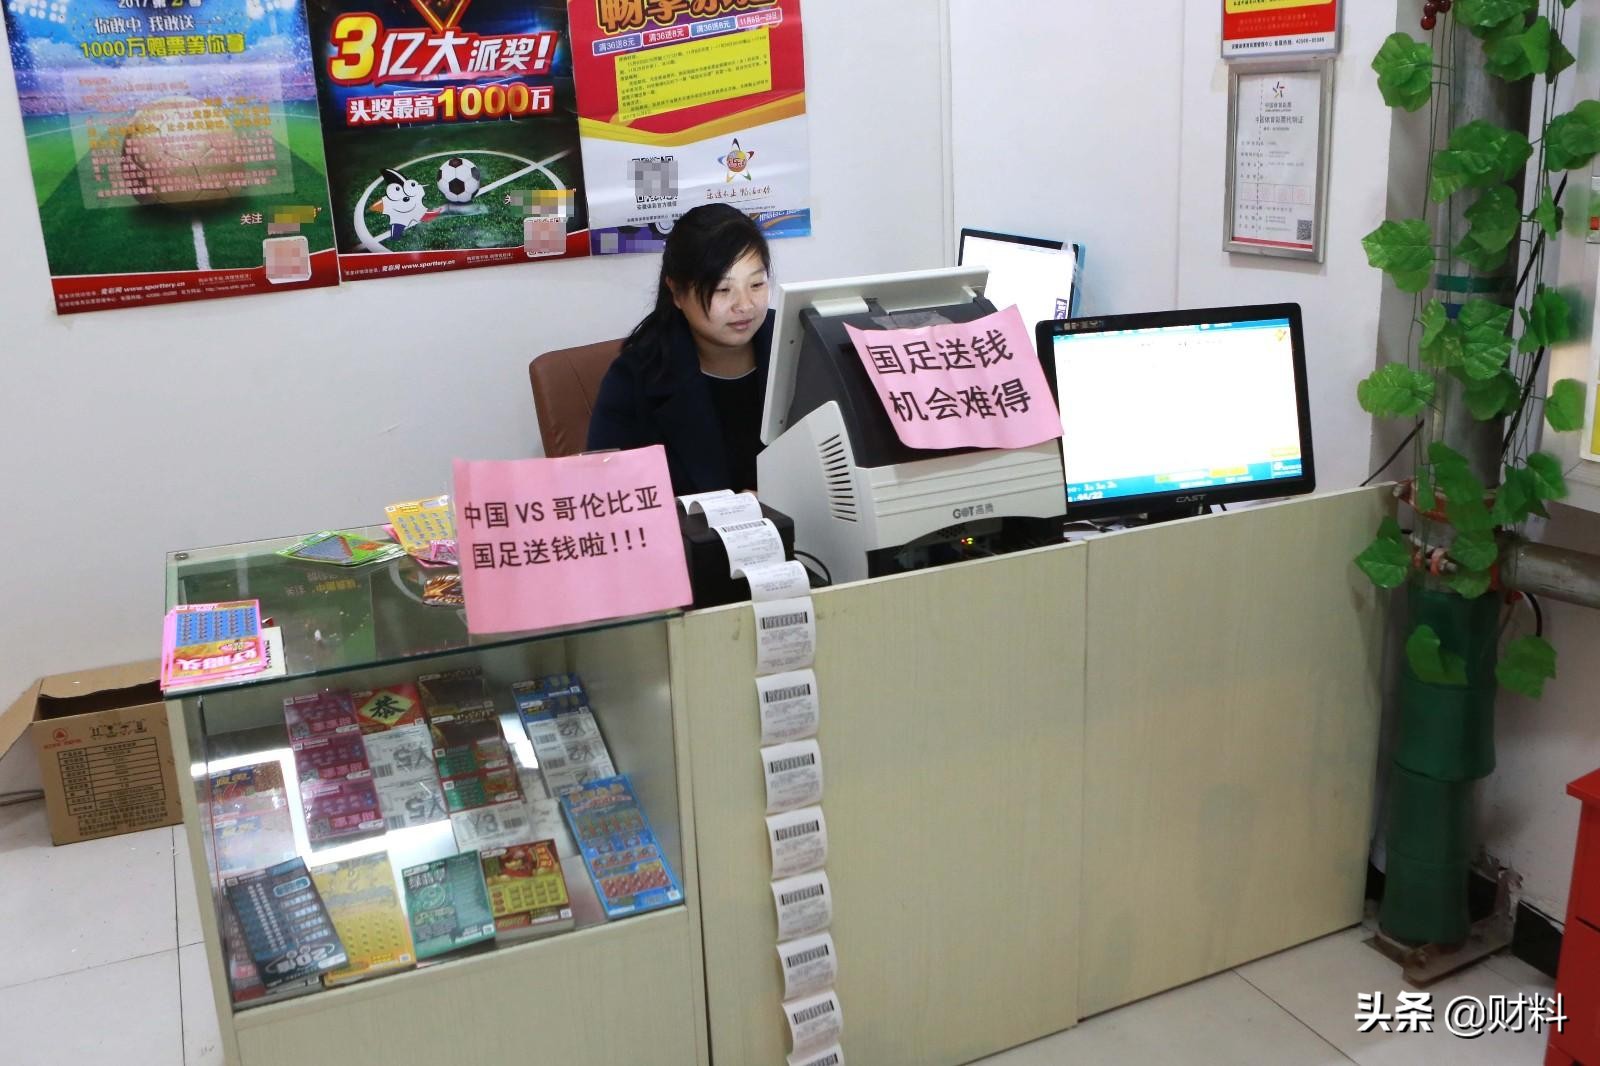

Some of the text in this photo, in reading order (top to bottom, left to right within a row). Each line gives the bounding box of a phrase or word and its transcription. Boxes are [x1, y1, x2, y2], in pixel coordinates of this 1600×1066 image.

[648, 28, 685, 42] 满36送8元
[696, 20, 732, 34] 满36送8元
[349, 84, 552, 122] 头奖最高1000万
[240, 212, 263, 225] 关注
[865, 328, 1014, 375] 国足送钱
[889, 377, 1032, 423] 机会难得
[464, 501, 510, 530] 中国
[514, 501, 546, 524] VS
[552, 484, 663, 522] 哥伦比亚
